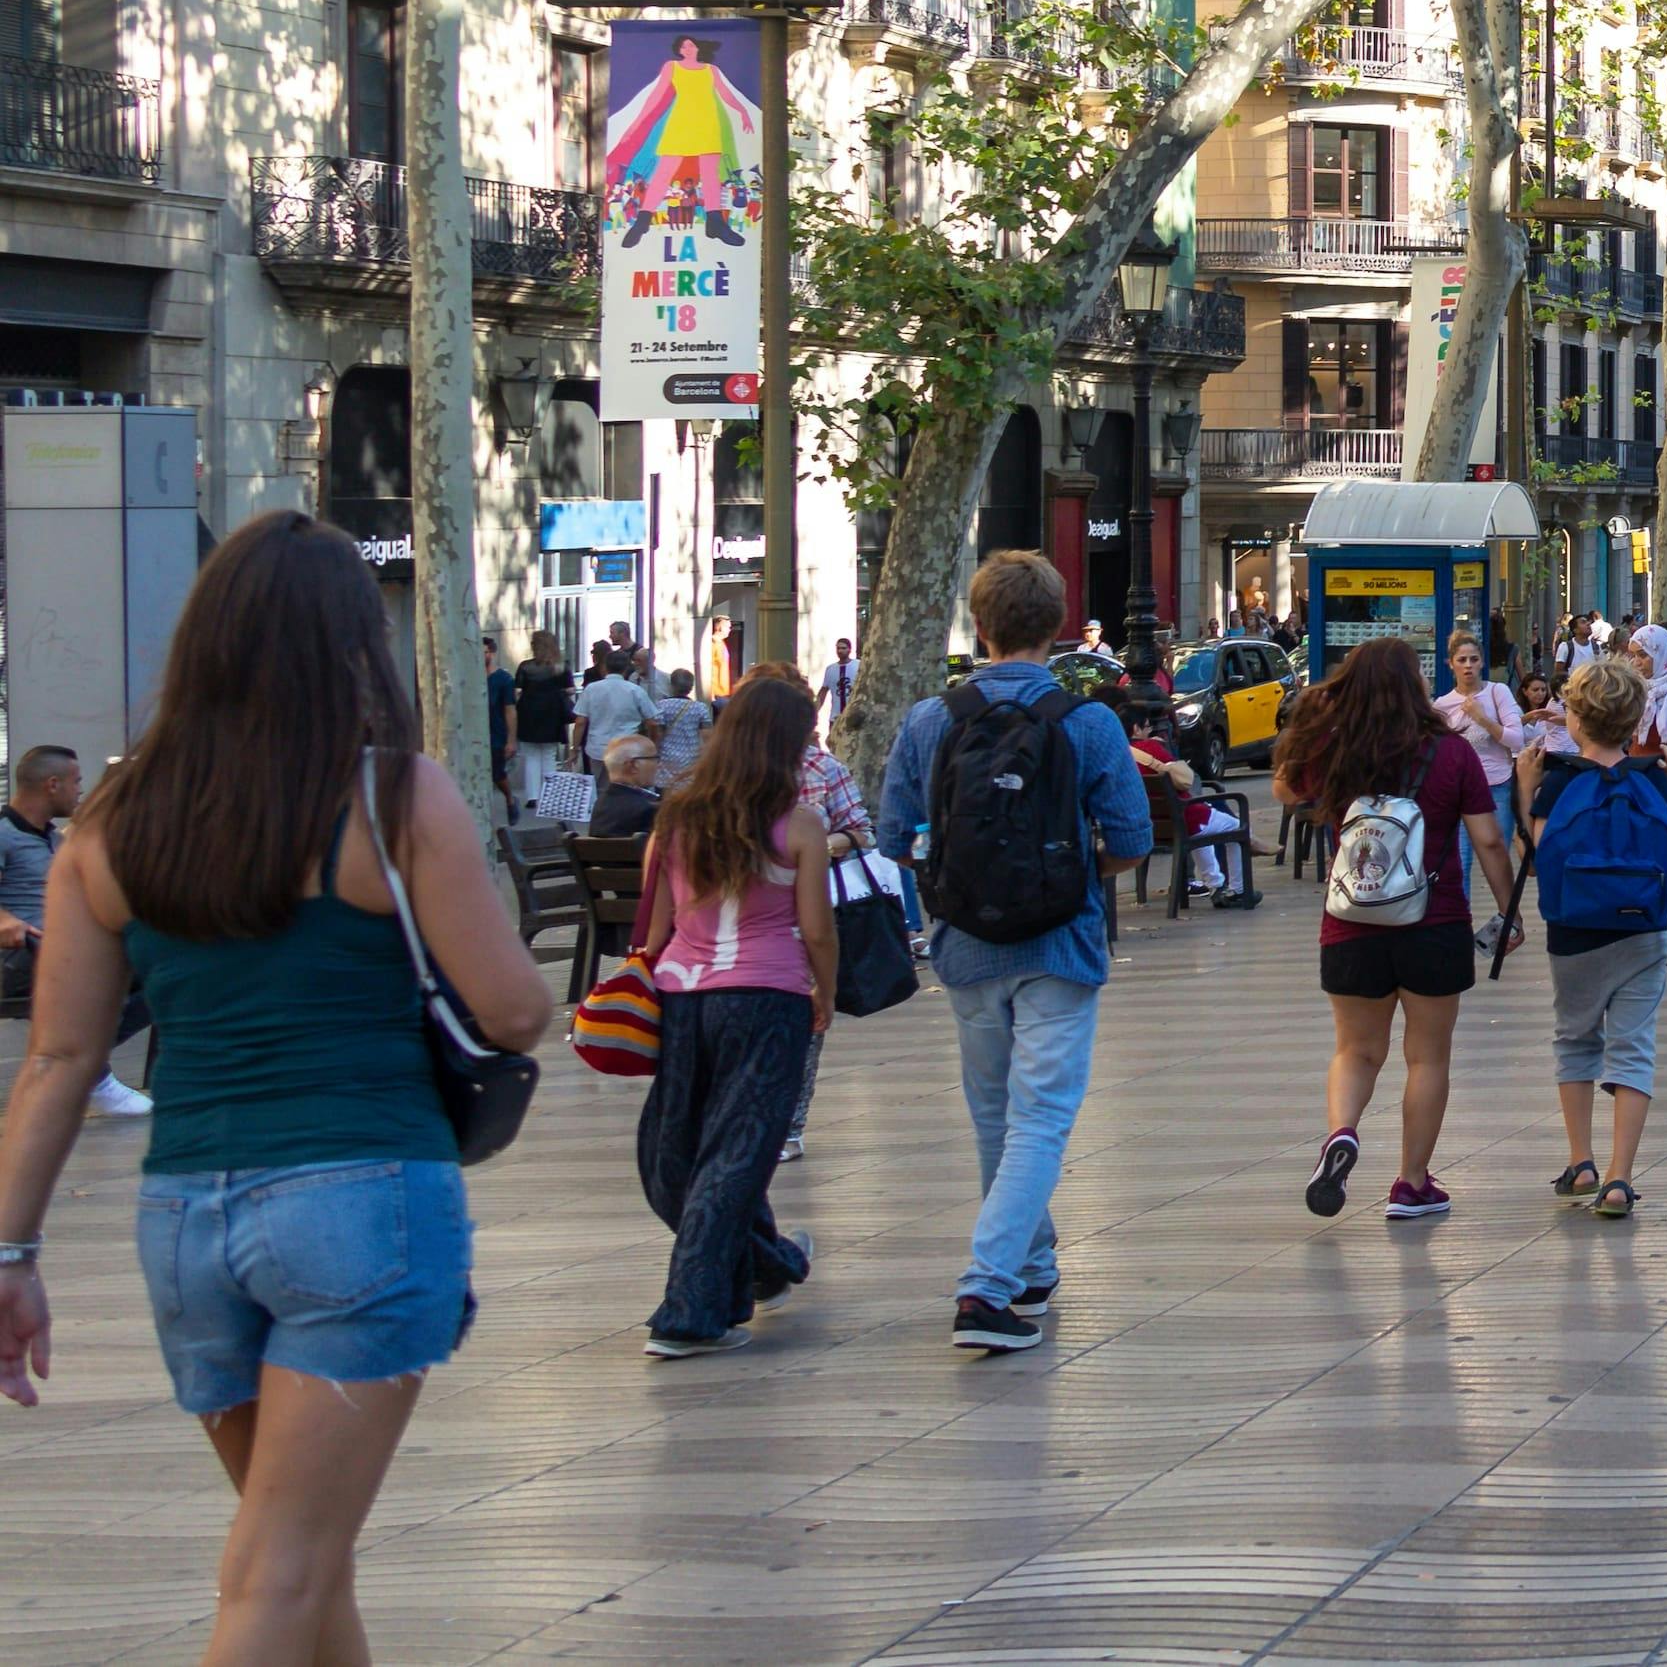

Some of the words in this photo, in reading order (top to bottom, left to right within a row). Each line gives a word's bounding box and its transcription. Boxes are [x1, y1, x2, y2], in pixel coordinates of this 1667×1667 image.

[664, 236, 698, 262] LA
[632, 262, 730, 298] MERCÈ
[656, 304, 697, 332] '18
[630, 342, 642, 353] 21
[652, 342, 667, 352] 24
[670, 340, 728, 352] Setembre
[674, 387, 720, 396] Barcelona
[1363, 581, 1375, 589] 90
